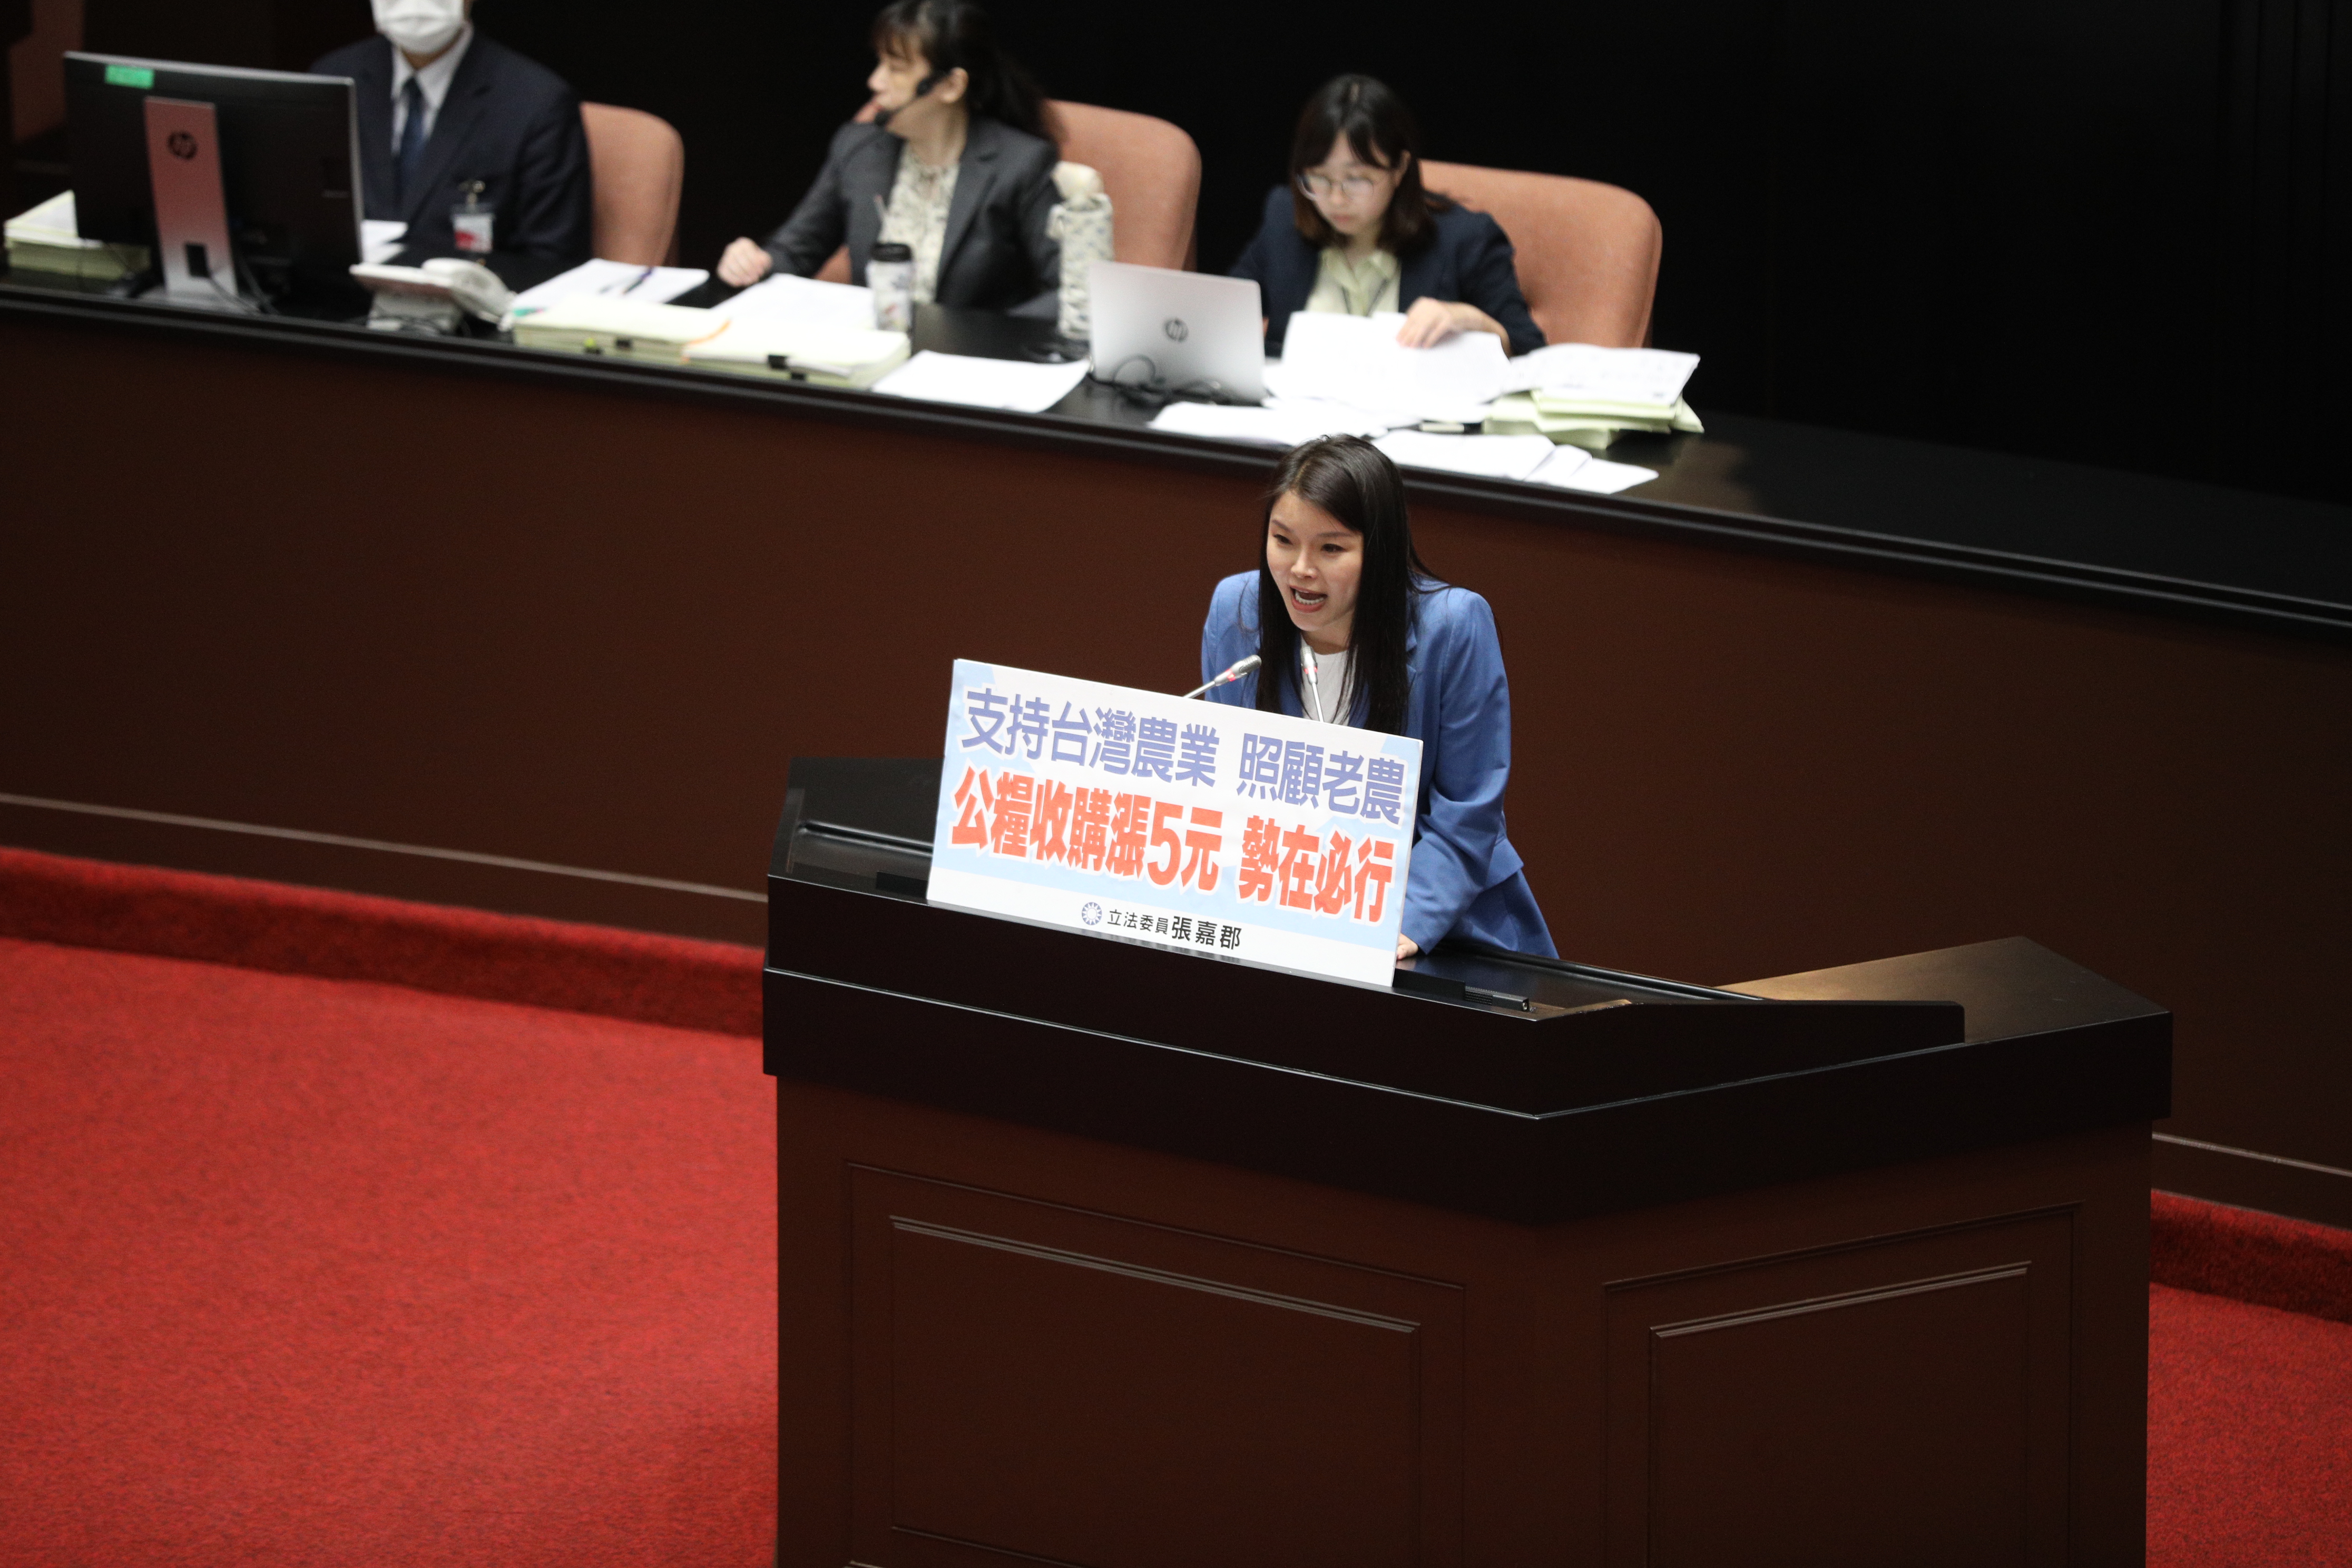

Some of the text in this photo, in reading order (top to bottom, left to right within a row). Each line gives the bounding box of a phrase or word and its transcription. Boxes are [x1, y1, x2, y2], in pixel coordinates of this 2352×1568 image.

[962, 688, 1404, 824] 支持台灣農業 照顧老農
[952, 767, 1394, 923] 公糧收購漲5元 勢在必行
